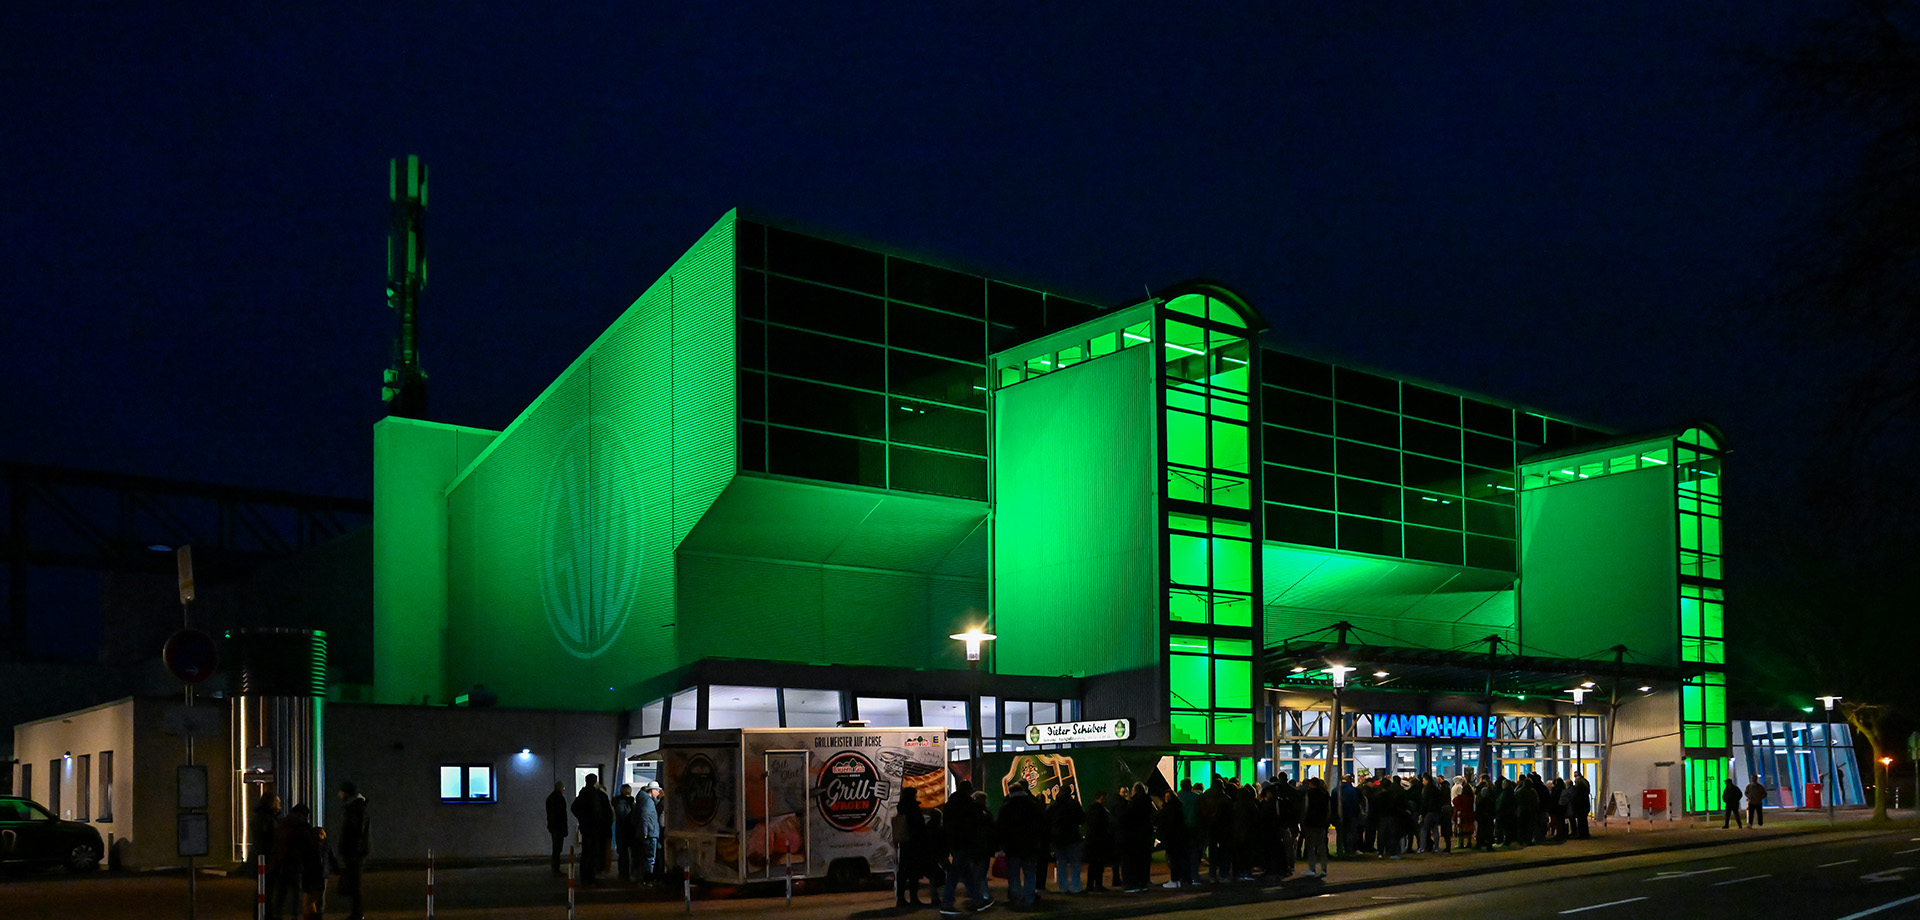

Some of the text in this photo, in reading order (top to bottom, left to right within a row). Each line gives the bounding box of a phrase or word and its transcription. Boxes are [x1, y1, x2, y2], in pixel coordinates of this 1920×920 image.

[1373, 713, 1497, 738] KAMPA-HALLE
[814, 735, 882, 748] GRILLMEISTER AUF ACHSE
[826, 778, 871, 807] Grill
[830, 800, 870, 811] WAGEN
